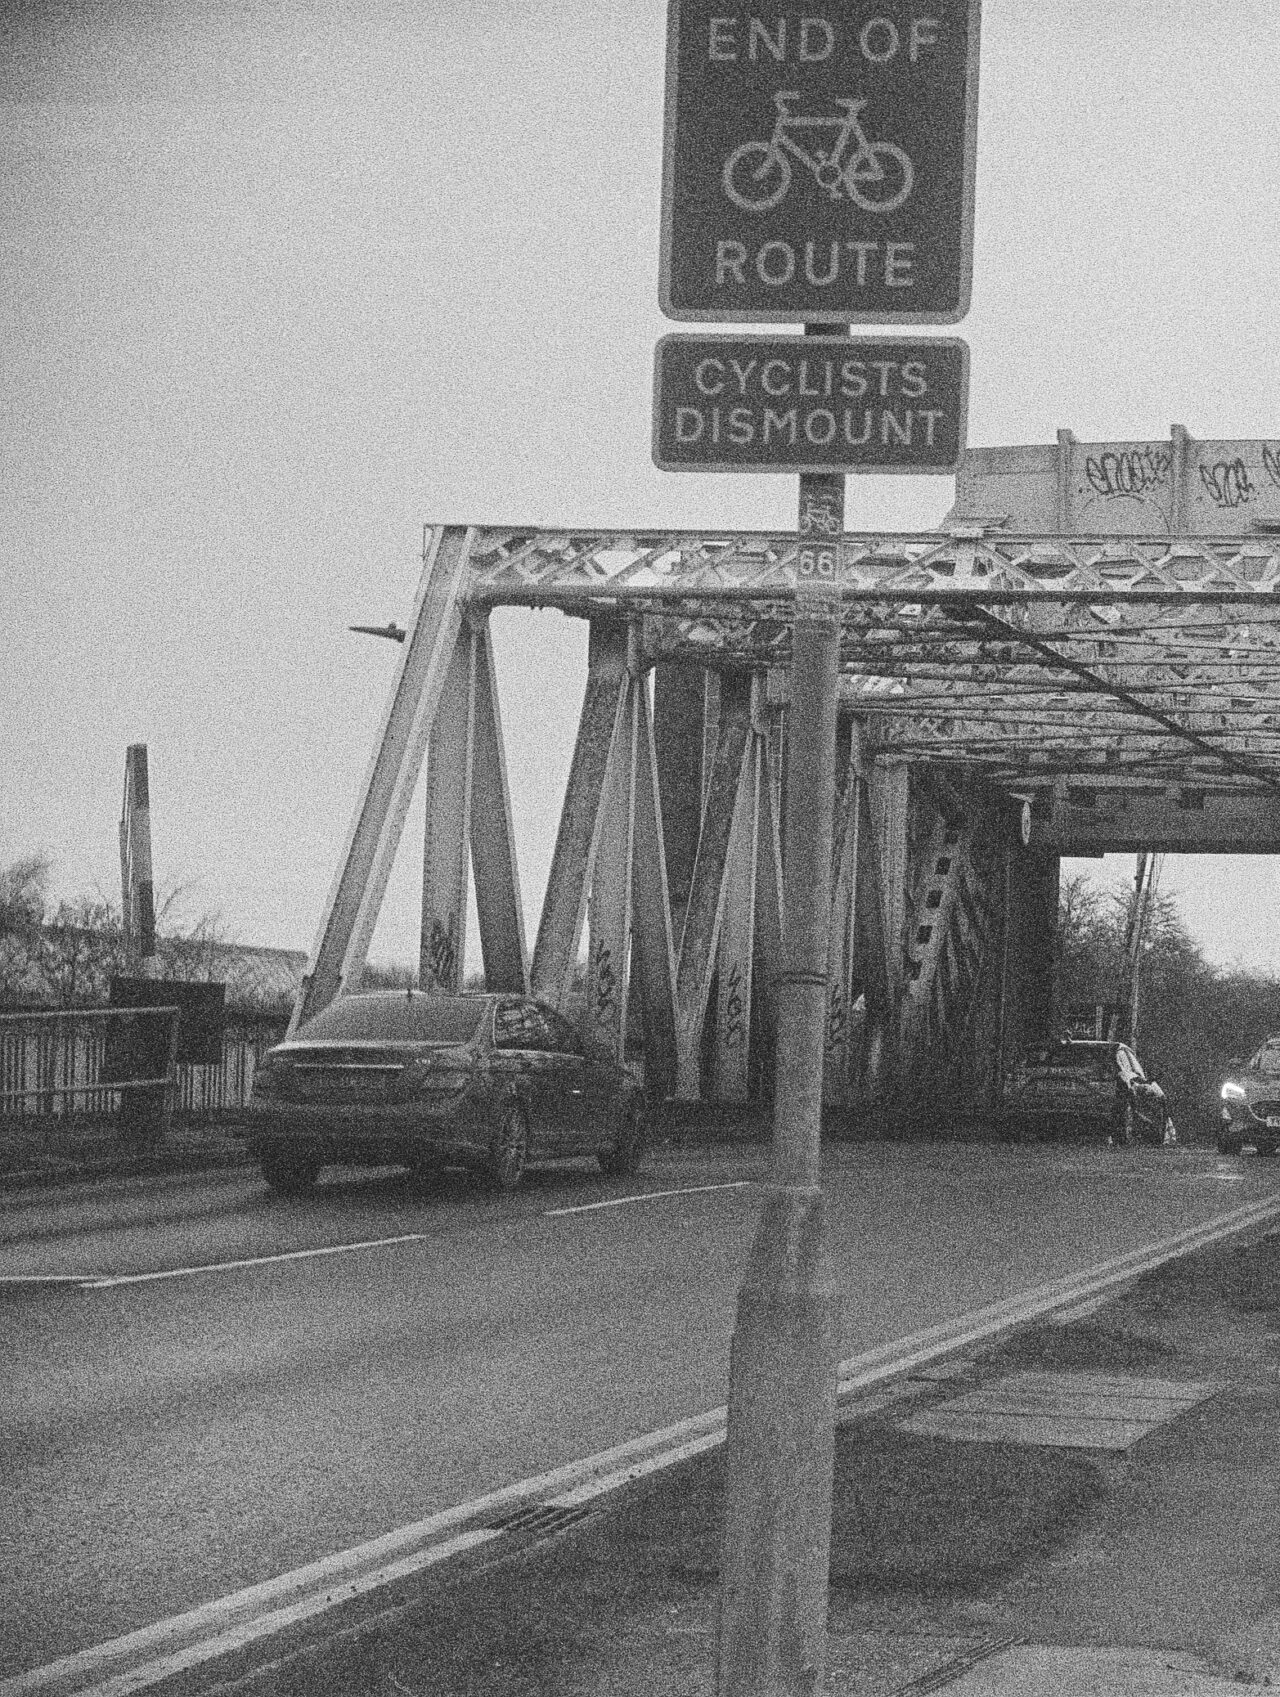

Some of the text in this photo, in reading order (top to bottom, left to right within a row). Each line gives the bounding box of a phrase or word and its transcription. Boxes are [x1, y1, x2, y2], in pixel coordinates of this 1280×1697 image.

[707, 16, 941, 63] END OF
[715, 239, 916, 286] ROUTE
[694, 357, 929, 397] CYCLISTS
[674, 406, 945, 446] DISMOUNT
[799, 550, 834, 575] 66
